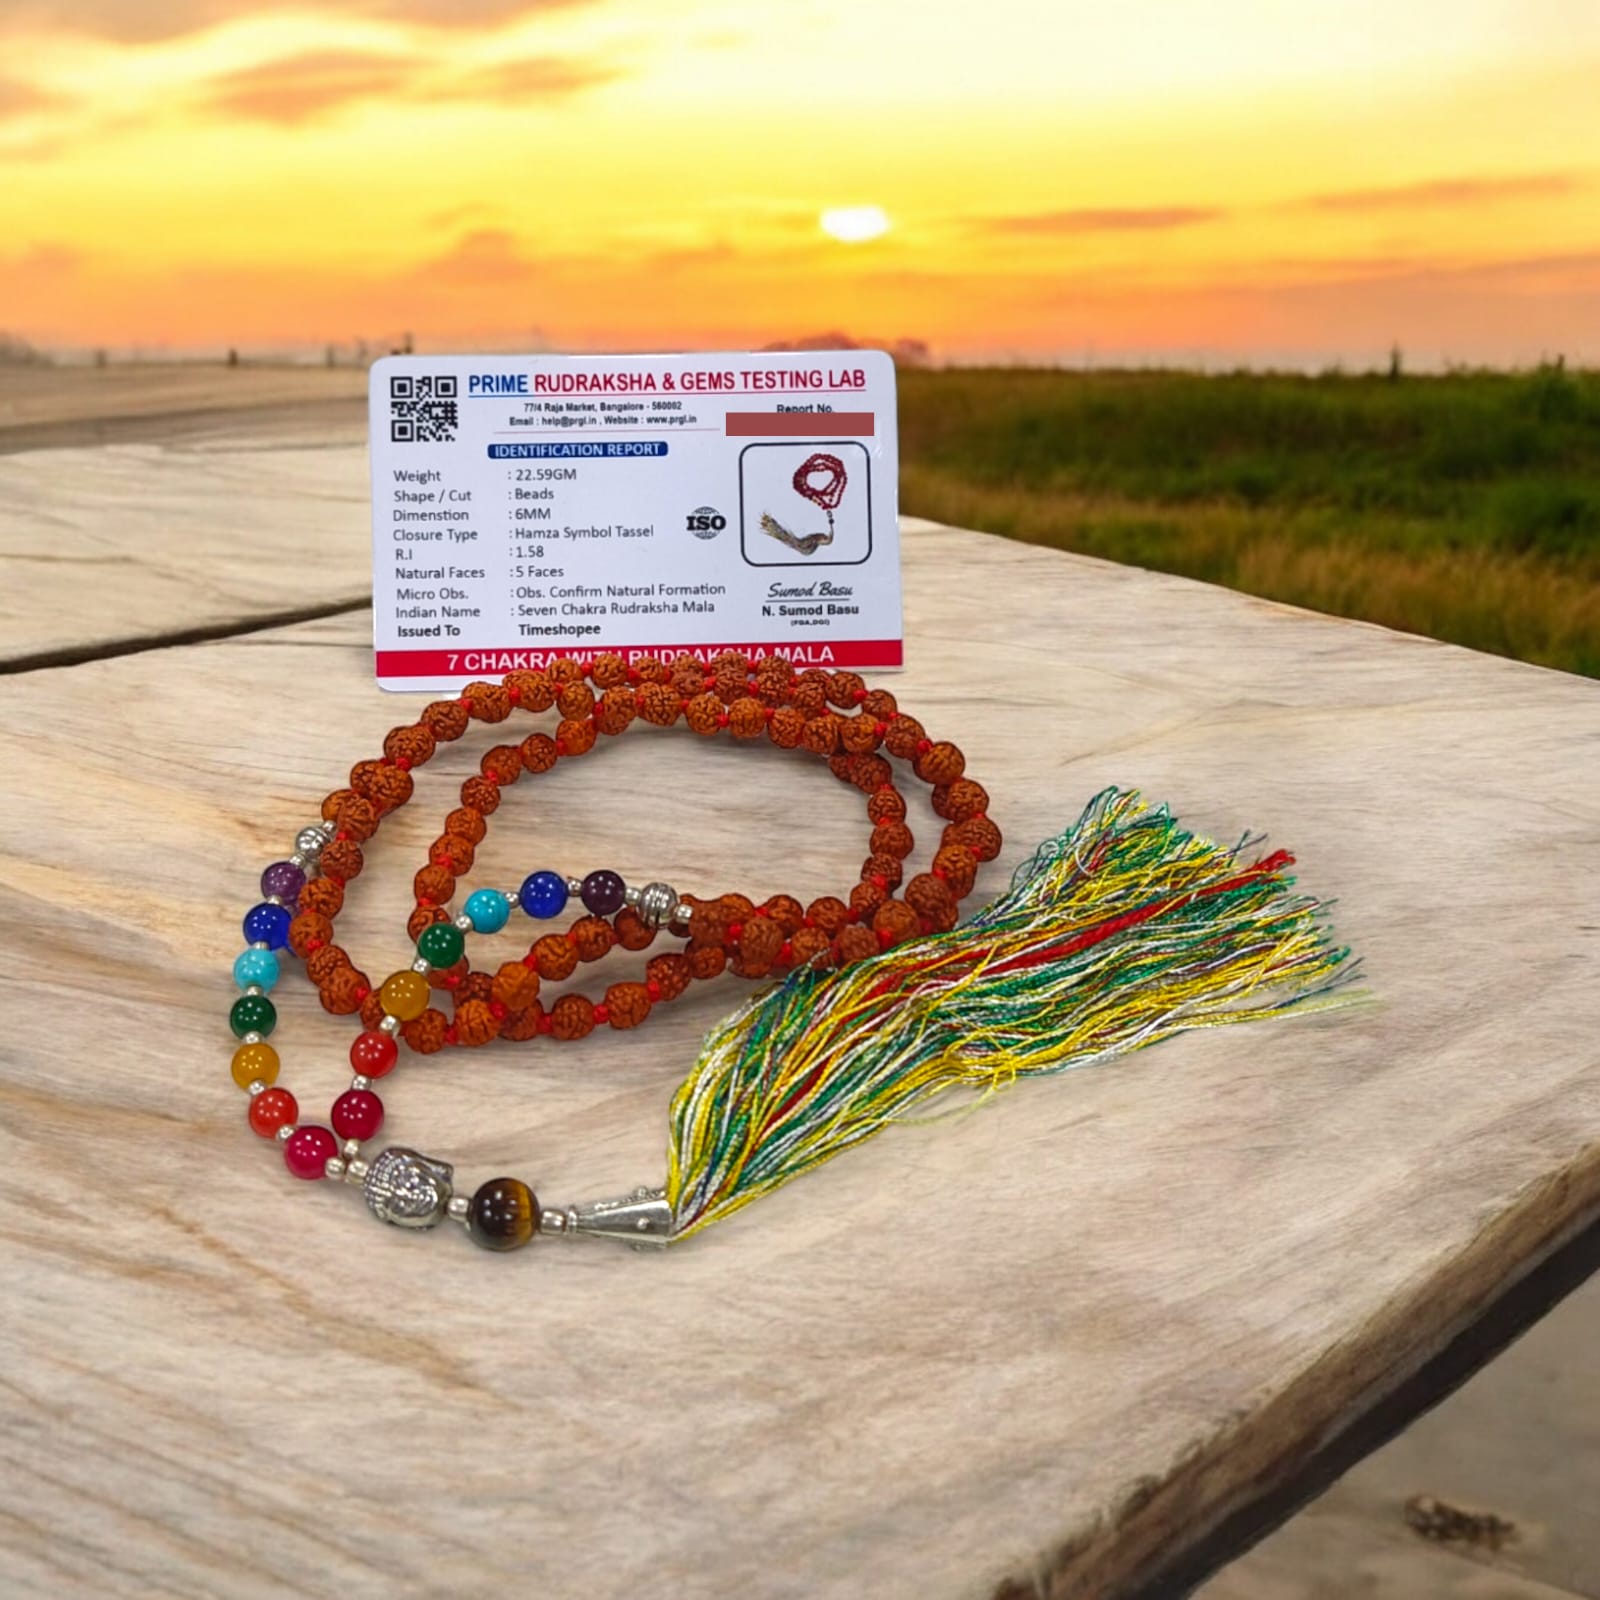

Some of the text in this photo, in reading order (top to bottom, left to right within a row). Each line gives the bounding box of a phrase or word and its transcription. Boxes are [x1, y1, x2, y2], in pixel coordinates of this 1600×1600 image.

[468, 369, 866, 393] PRIME RUDRAKSHA & GEMS TESTING LAB
[544, 403, 563, 414] Raja
[565, 403, 598, 413] Market,
[600, 402, 644, 413] Bangalore
[509, 417, 534, 426] Email
[604, 415, 638, 425] Website
[494, 443, 660, 458] IDENTIFICATION REPORT
[394, 470, 442, 483] Weight
[516, 469, 577, 481] 22.59GM
[394, 491, 435, 504] Shape
[449, 491, 472, 502] Cut
[515, 488, 554, 500] Beads
[393, 510, 469, 522] Dimenstion
[515, 508, 551, 520] 6MM
[686, 515, 727, 531] ISO
[393, 529, 443, 542] Closure
[447, 529, 478, 543] Type
[516, 528, 560, 539] Hamza
[563, 527, 611, 541] Symbol
[615, 526, 654, 538] Tassel
[516, 546, 544, 558] 1.58
[395, 567, 445, 579] Natural
[449, 567, 485, 579] Faces
[516, 566, 524, 578] 5
[528, 566, 564, 578] Faces
[396, 589, 435, 601] Micro
[439, 588, 469, 600] Obs.
[516, 587, 546, 599] Obs.
[549, 586, 602, 598] Confirm
[607, 585, 655, 597] Natural
[659, 584, 726, 596] Formation
[767, 581, 853, 598] Sumod Basu
[396, 606, 437, 619] Indian
[441, 606, 481, 618] Name
[518, 605, 557, 616] Seven
[561, 604, 607, 615] Chakra
[611, 602, 678, 614] Rudraksha
[683, 601, 715, 613] Mala
[762, 604, 859, 617] N. Sumod Basu
[397, 623, 601, 638] Issued To Timeshopee
[447, 653, 459, 671] 7
[464, 651, 559, 671] CHAKRA
